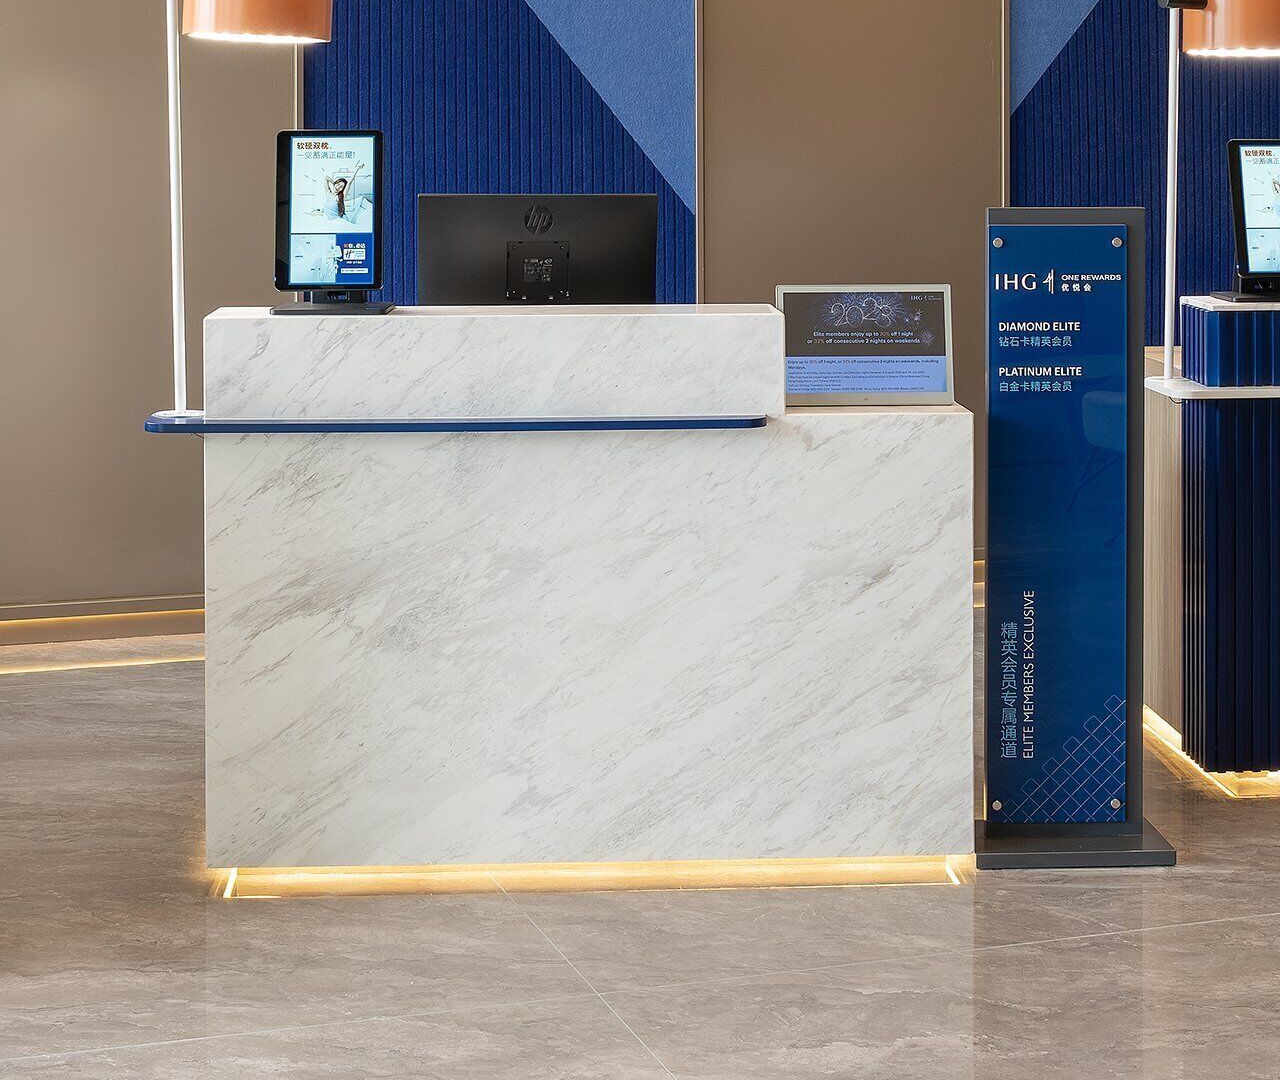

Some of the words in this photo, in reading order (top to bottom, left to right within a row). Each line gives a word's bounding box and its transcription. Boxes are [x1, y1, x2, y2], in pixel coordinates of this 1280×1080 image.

[526, 205, 552, 235] hp
[995, 274, 1037, 290] IHG
[1061, 284, 1092, 292] 优悦会
[999, 322, 1050, 331] DIAMOND
[1053, 322, 1080, 331] ELITE
[999, 336, 1072, 346] 钻石卡精英会员
[999, 367, 1051, 376] PLATINUM
[1055, 367, 1082, 376] ELITE
[1000, 381, 1072, 392] 白金卡精英会员
[1023, 591, 1035, 659] EXCLUSIVE
[1000, 622, 1018, 758] 精英会员专属通道
[1023, 663, 1034, 722] MEMBERS
[1023, 726, 1034, 759] ELITE
